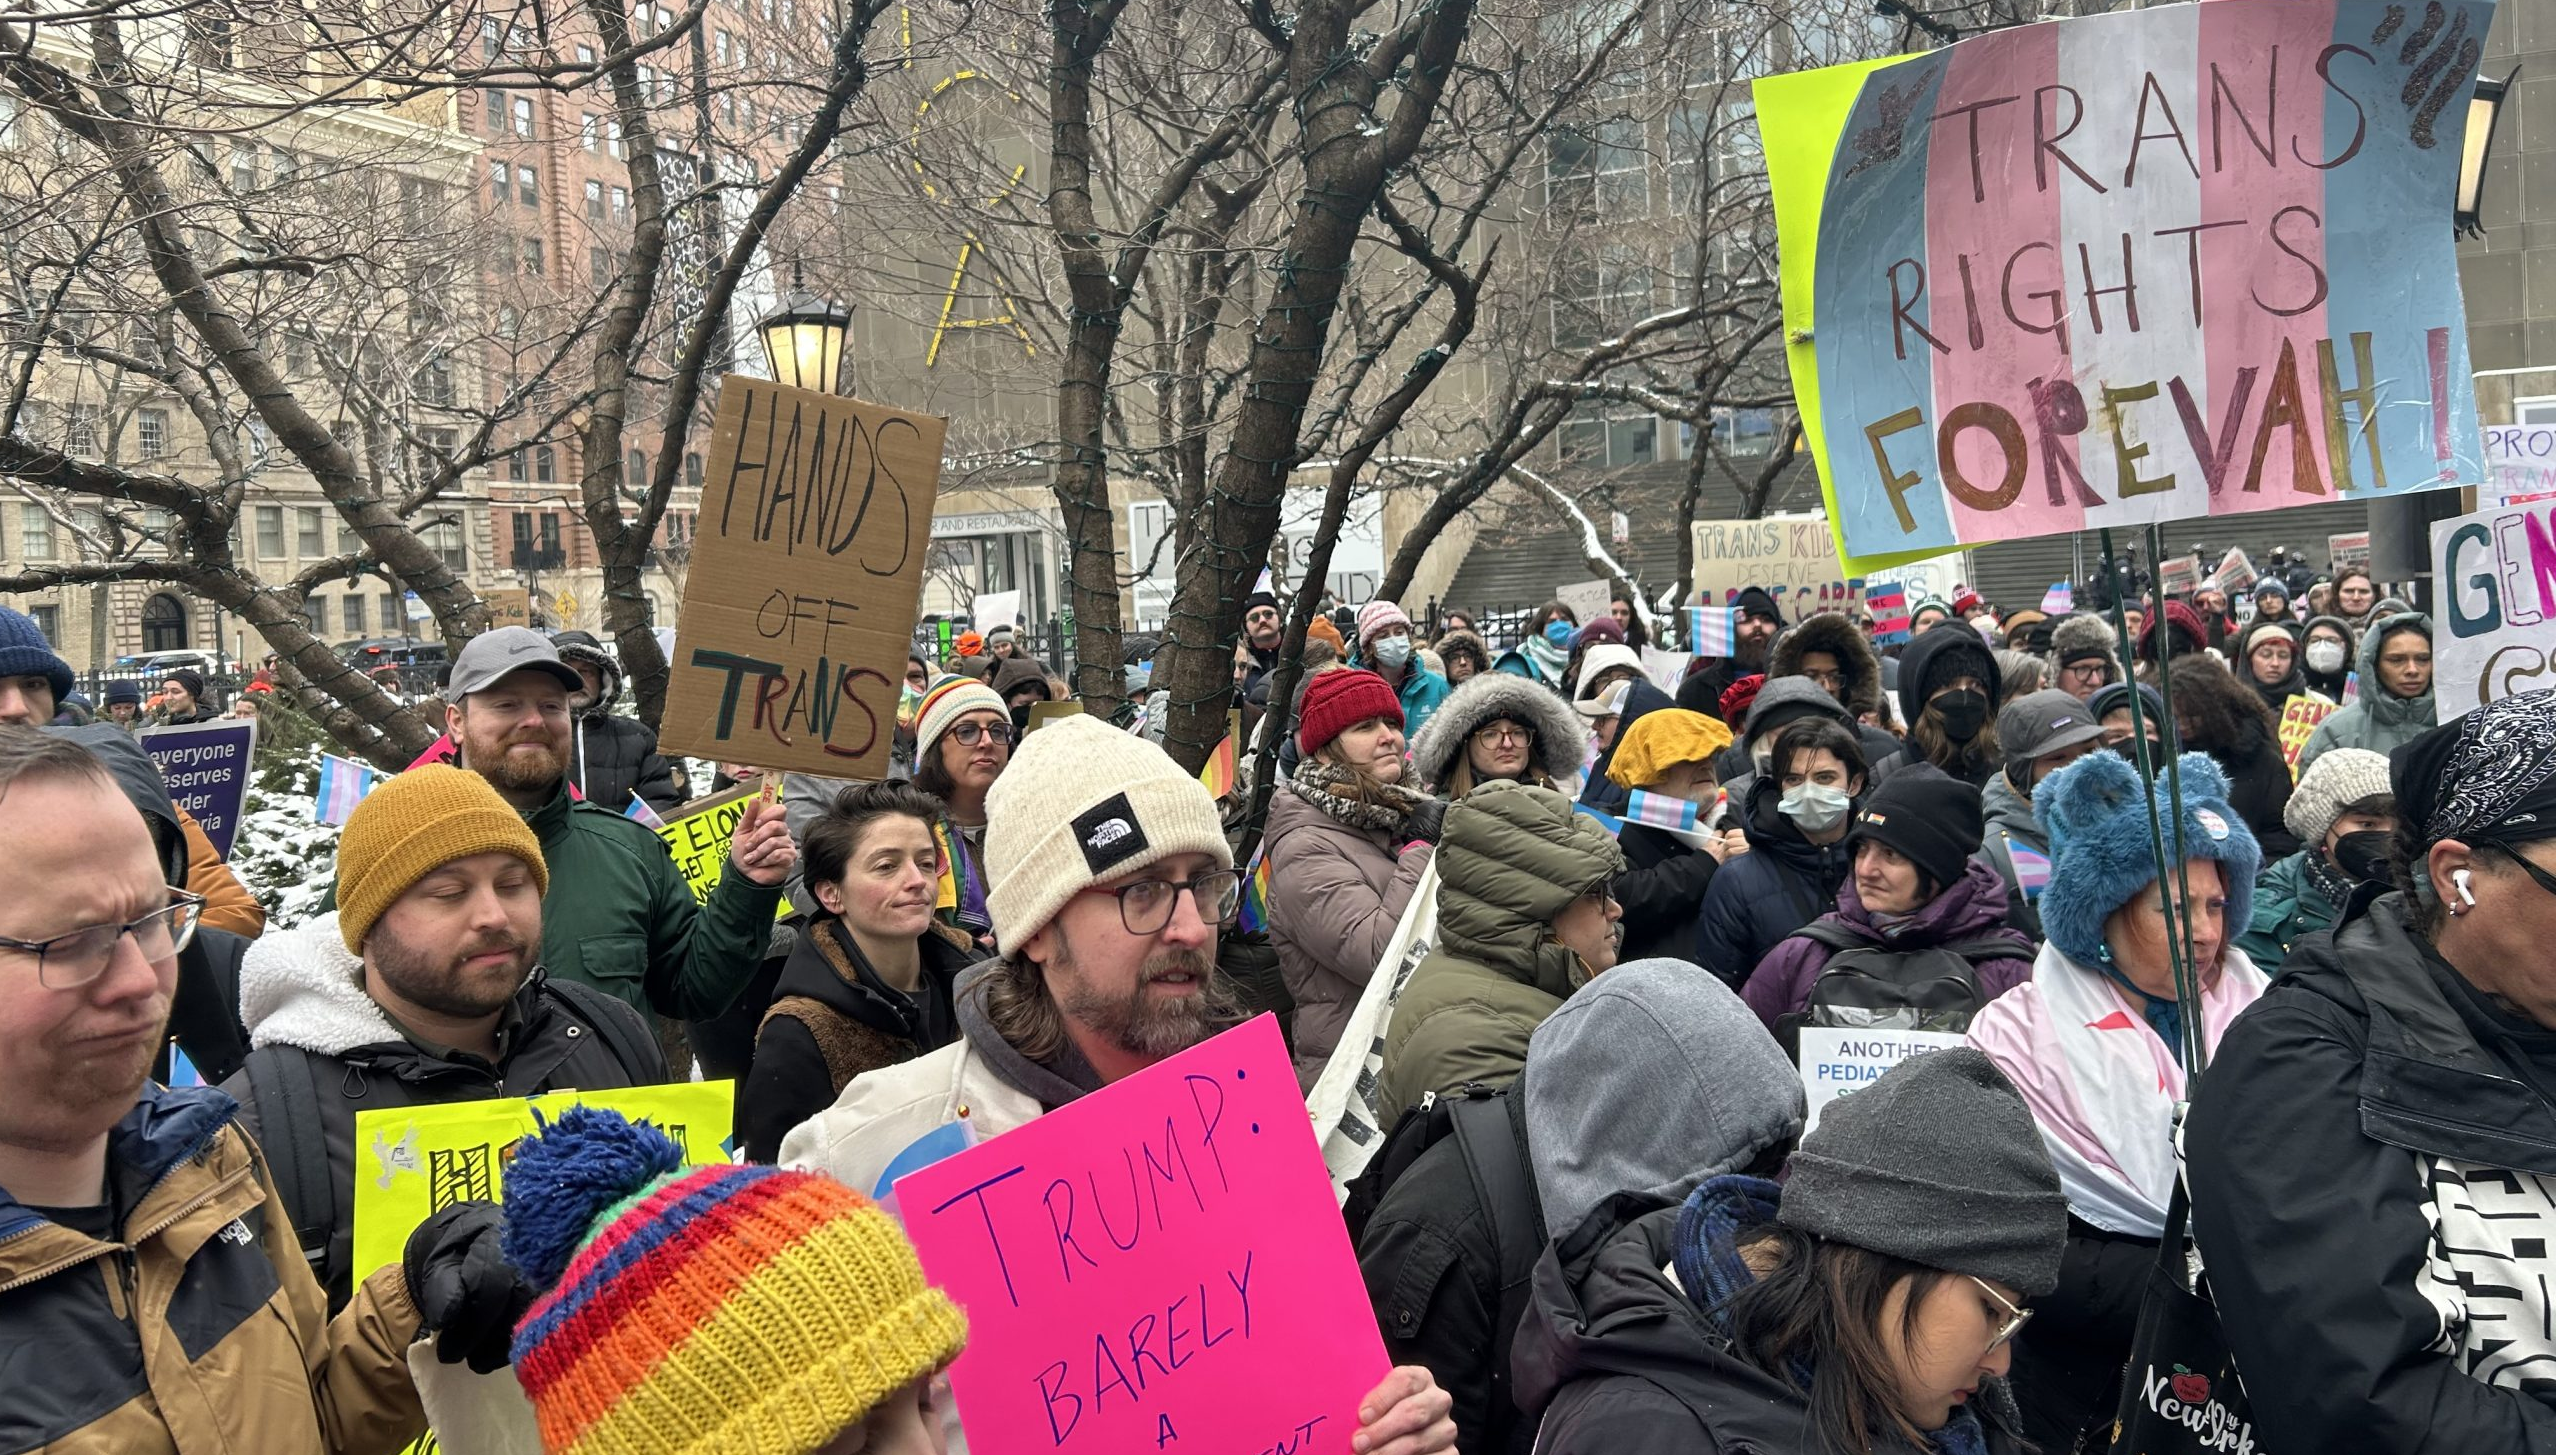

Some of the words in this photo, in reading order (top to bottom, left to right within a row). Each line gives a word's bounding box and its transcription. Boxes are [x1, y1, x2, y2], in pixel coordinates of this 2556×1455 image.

[1931, 43, 2377, 204] TRANS
[673, 283, 706, 307] MCA
[1885, 205, 2329, 361] RIGHTS
[721, 388, 921, 577] HANDS
[940, 520, 965, 532] AND
[966, 514, 1037, 530] RESTAURANT
[1697, 522, 1781, 560] TRANS
[1789, 523, 1837, 558] KID
[1736, 562, 1820, 585] DESERVE
[756, 588, 860, 656] OFF
[690, 648, 893, 759] TRANS
[150, 743, 235, 767] everyone
[161, 767, 232, 788] eserves
[1087, 827, 1116, 847] NORTH
[1094, 821, 1112, 834] THE
[1096, 833, 1117, 849] FACE
[1818, 1064, 1891, 1081] PEDIAT
[932, 1069, 1260, 1308] TRUMP:
[1033, 1250, 1253, 1446] BARELY
[1156, 1413, 1178, 1450] A
